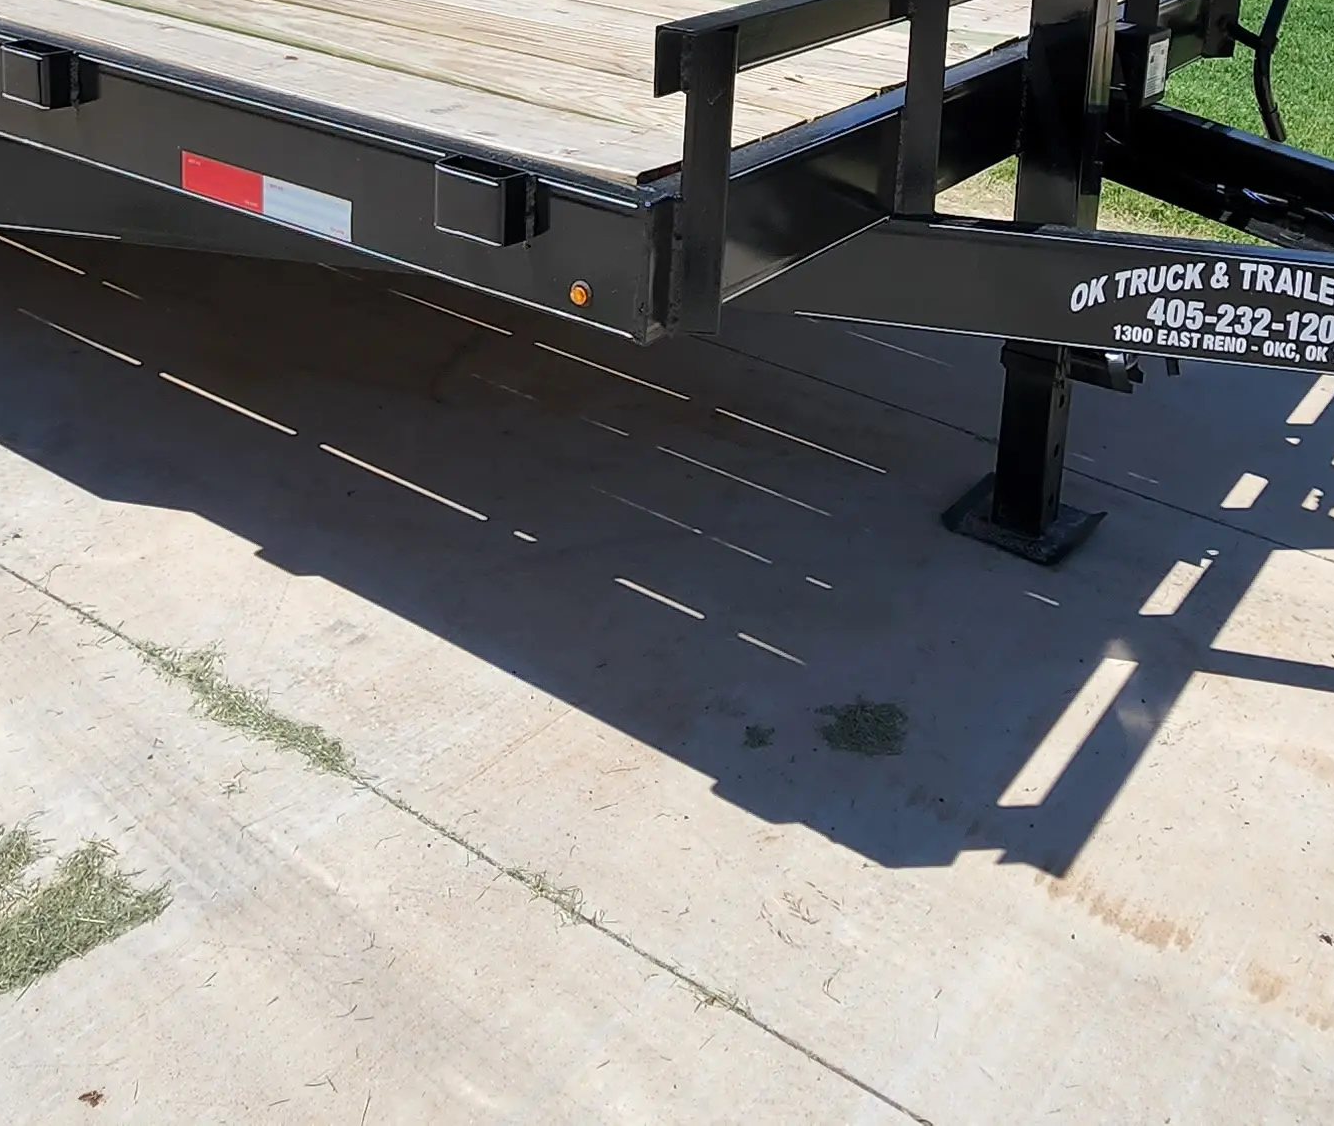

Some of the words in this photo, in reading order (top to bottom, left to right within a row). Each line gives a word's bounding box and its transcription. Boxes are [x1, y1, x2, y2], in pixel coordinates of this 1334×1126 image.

[1070, 274, 1109, 312] OK
[1114, 262, 1206, 299] TRUCK
[1209, 261, 1230, 289] &
[1113, 324, 1154, 344] 1300
[1156, 328, 1202, 349] EAST
[1202, 333, 1247, 354] RENO
[1262, 340, 1302, 363] OKC,
[1305, 344, 1329, 363] OK
